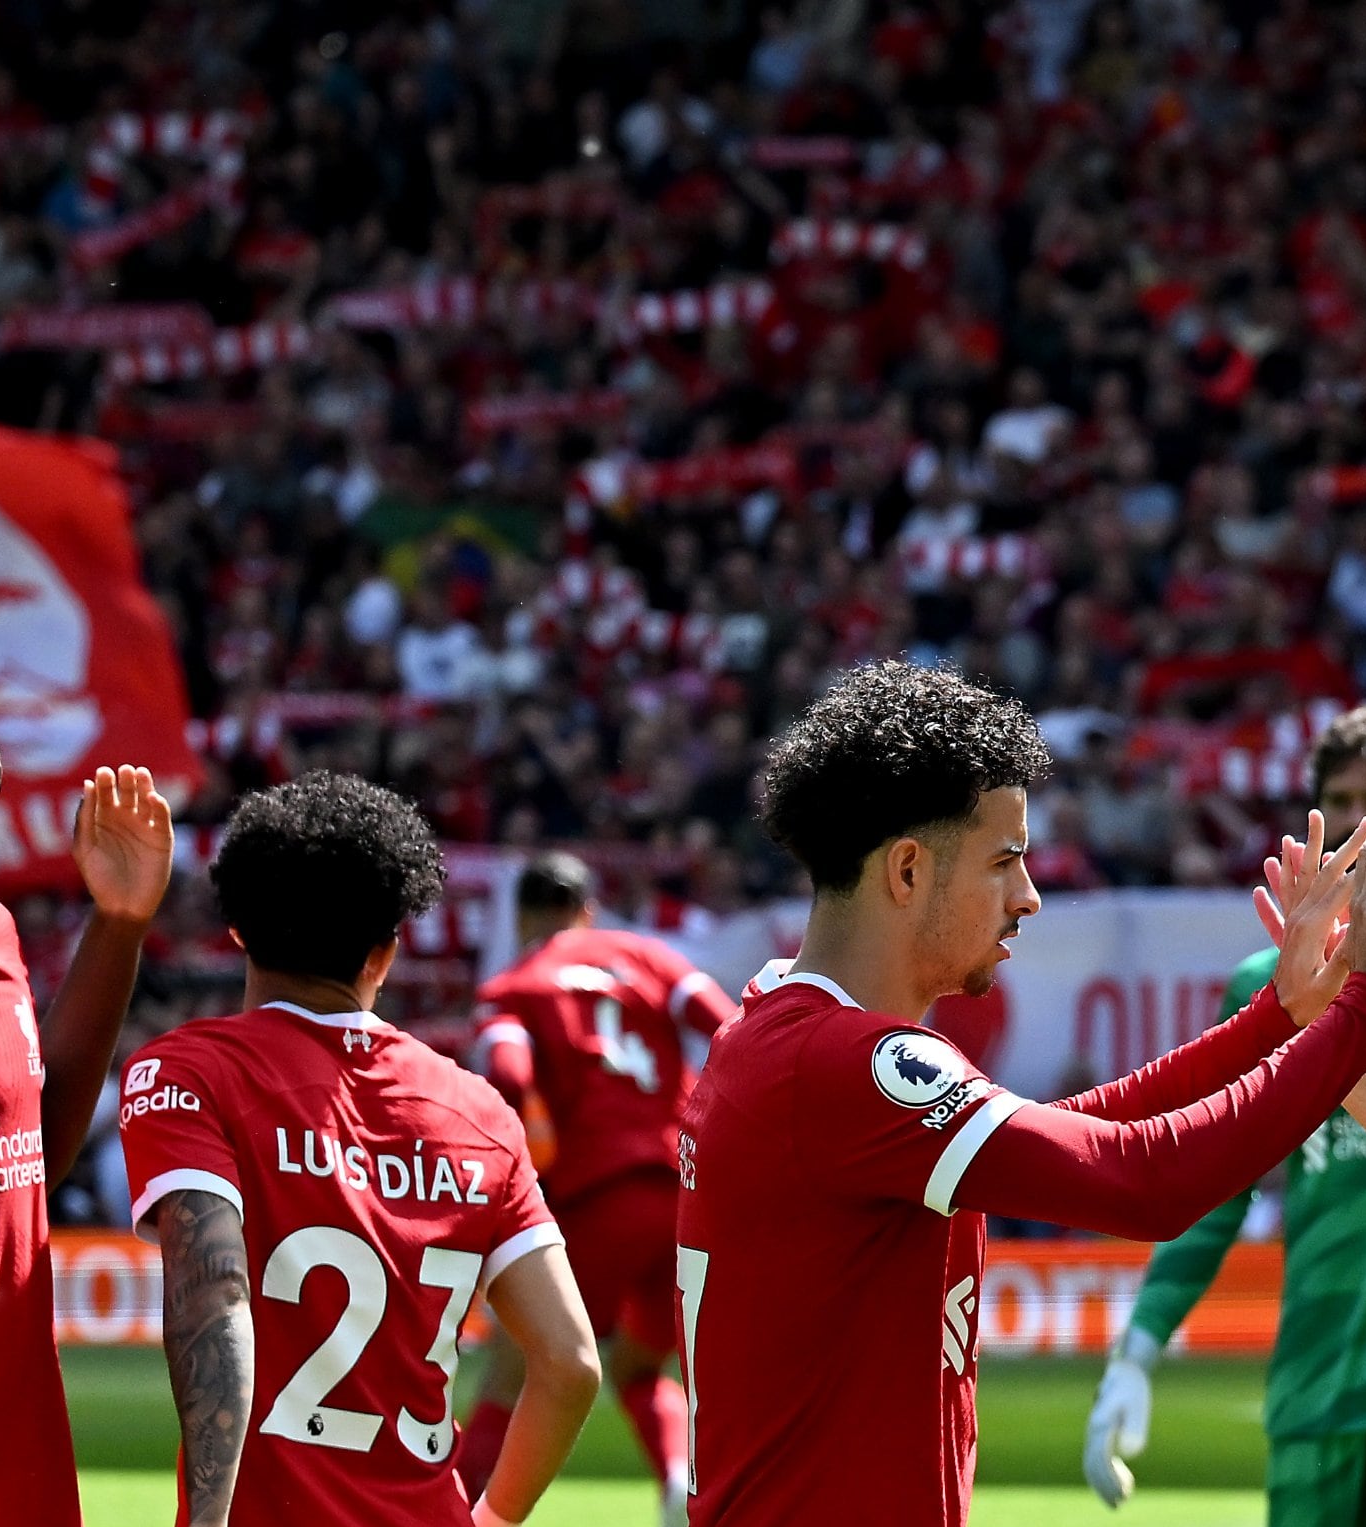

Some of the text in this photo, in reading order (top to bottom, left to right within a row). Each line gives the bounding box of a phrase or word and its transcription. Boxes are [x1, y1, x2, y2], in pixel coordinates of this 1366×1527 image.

[594, 996, 658, 1093] 4
[119, 1084, 201, 1132] pedia
[275, 1126, 489, 1205] LUIS DÍAZ
[258, 1225, 484, 1464] 23
